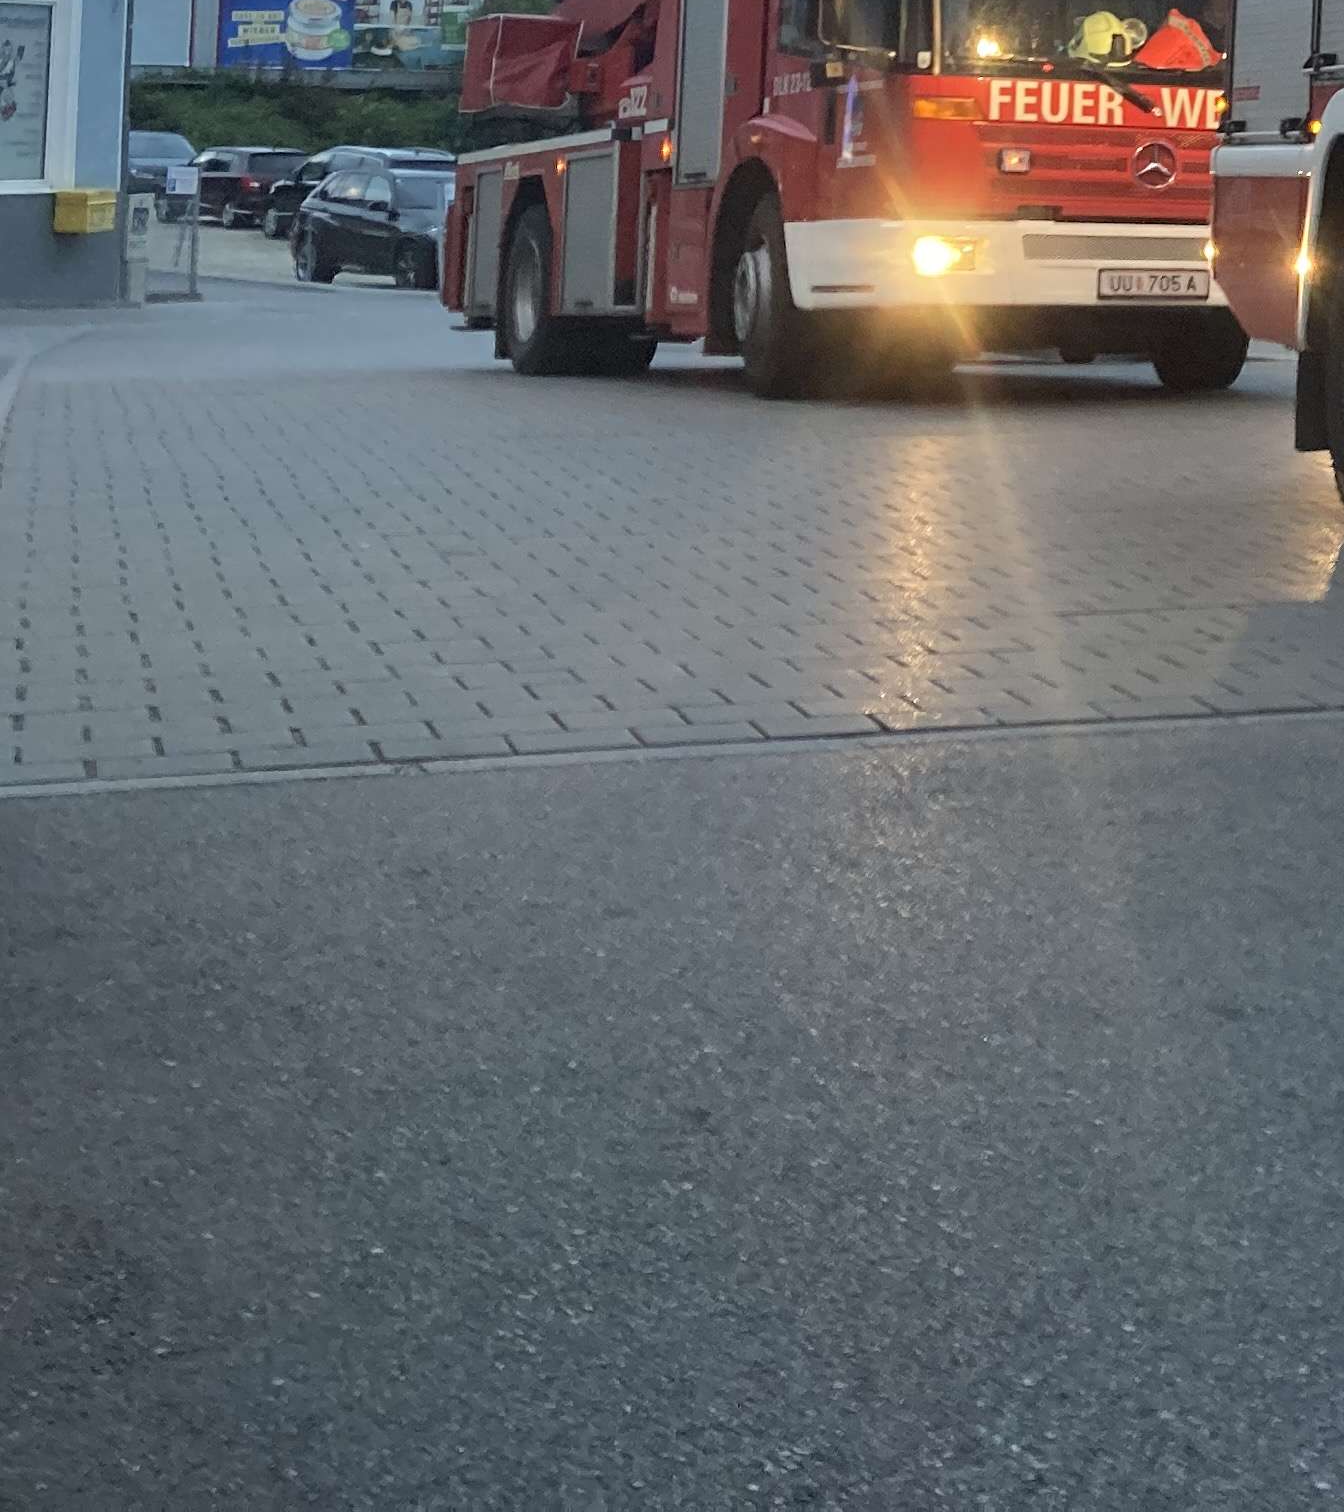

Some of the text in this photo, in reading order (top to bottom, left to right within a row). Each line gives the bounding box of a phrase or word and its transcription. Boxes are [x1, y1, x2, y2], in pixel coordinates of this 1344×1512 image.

[988, 79, 1124, 126] FEUER
[1110, 274, 1198, 293] UU 705 A
